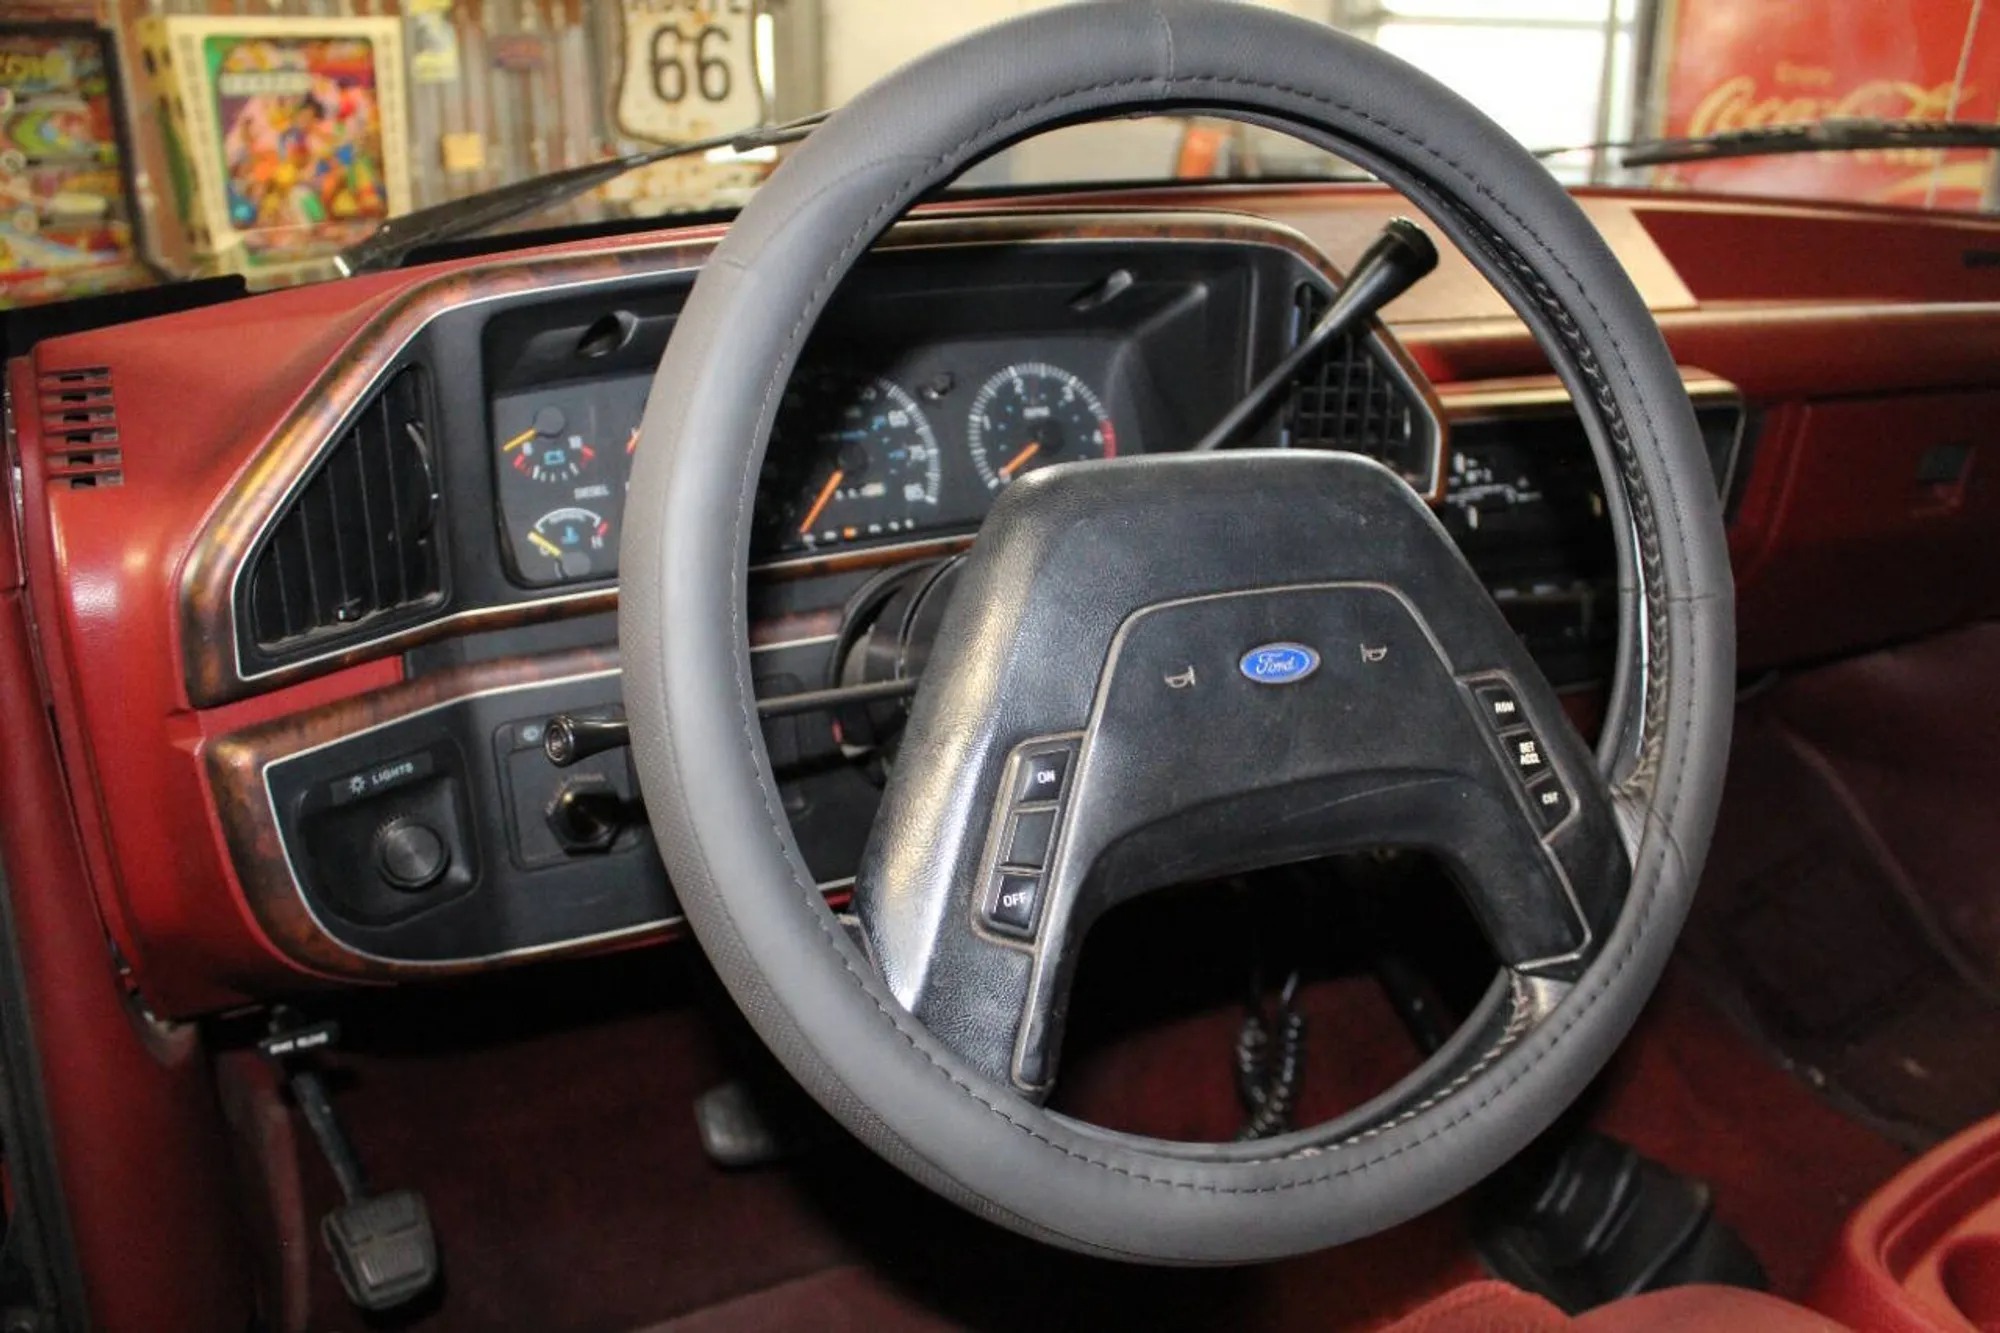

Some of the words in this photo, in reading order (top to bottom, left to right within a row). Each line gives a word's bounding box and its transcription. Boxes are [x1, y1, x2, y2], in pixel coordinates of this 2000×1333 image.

[650, 23, 732, 103] 66
[372, 762, 413, 785] LIGHTS
[1037, 770, 1056, 784] ON
[1003, 892, 1027, 908] OFF
